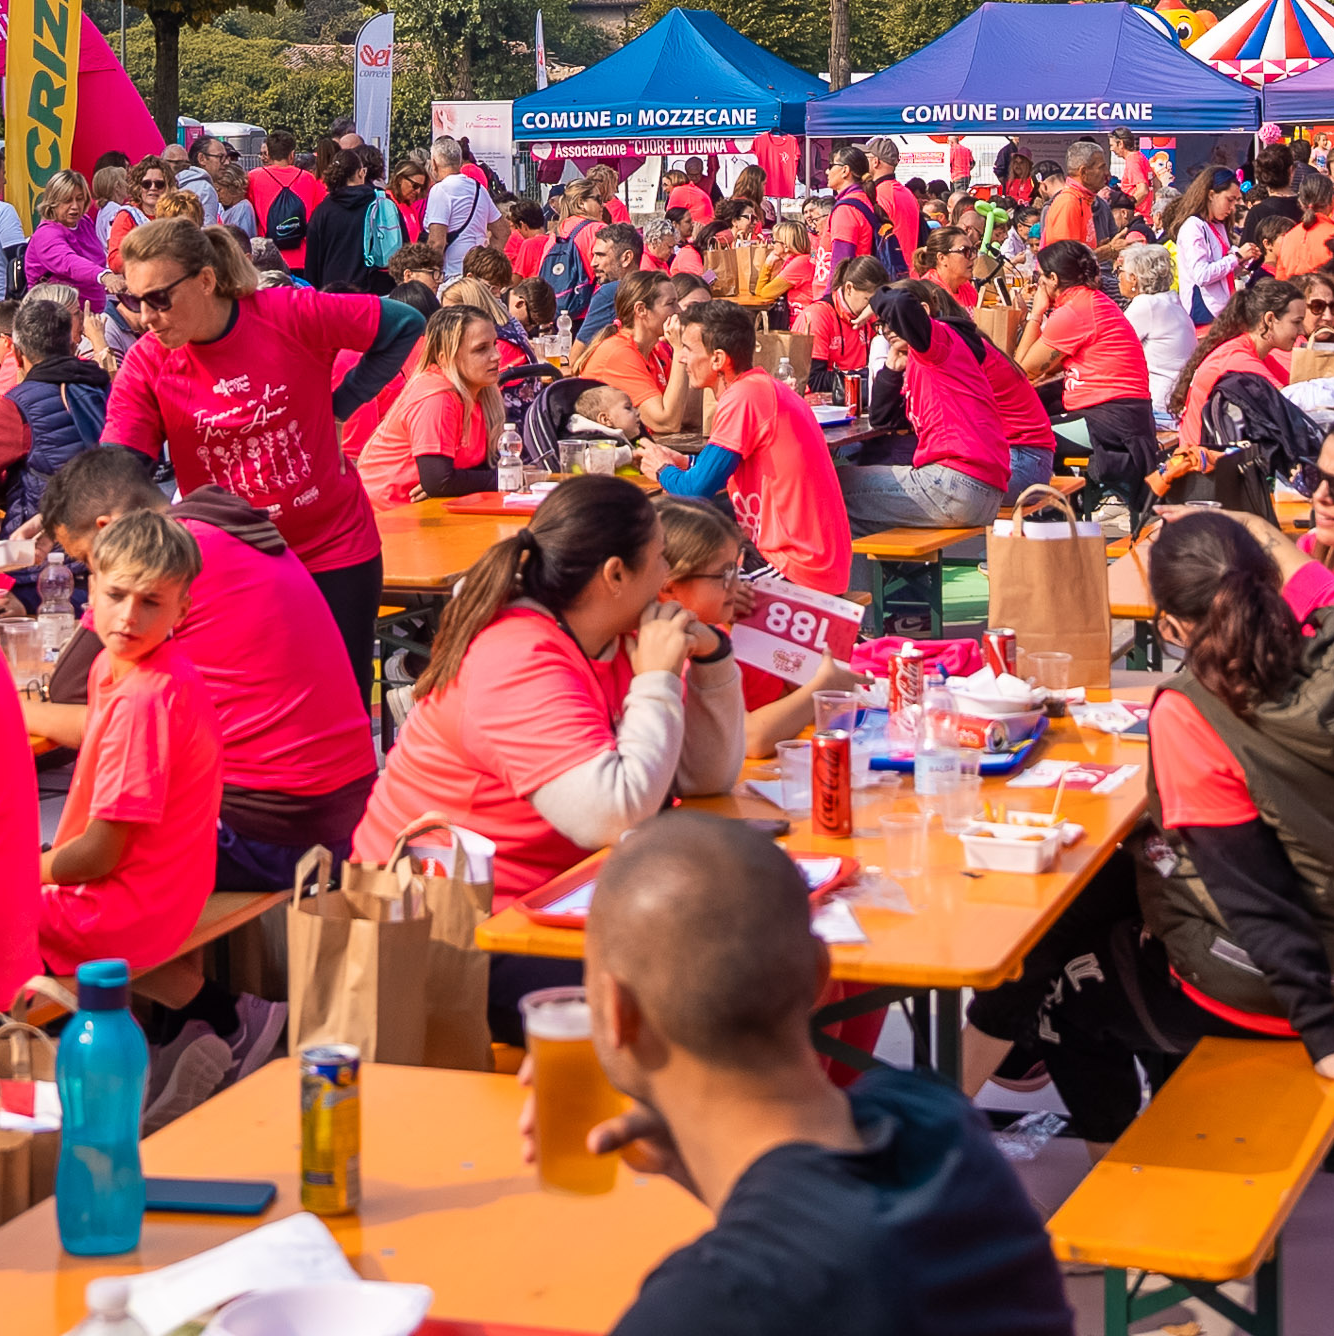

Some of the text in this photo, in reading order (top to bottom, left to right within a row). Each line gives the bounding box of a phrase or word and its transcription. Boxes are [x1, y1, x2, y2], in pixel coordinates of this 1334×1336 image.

[521, 110, 611, 129] COMUNE
[637, 108, 757, 127] MOZZECANE
[901, 103, 997, 124] COMUNE
[1025, 102, 1153, 121] MOZZECANE
[554, 141, 627, 158] Associazione
[673, 140, 685, 155] DI
